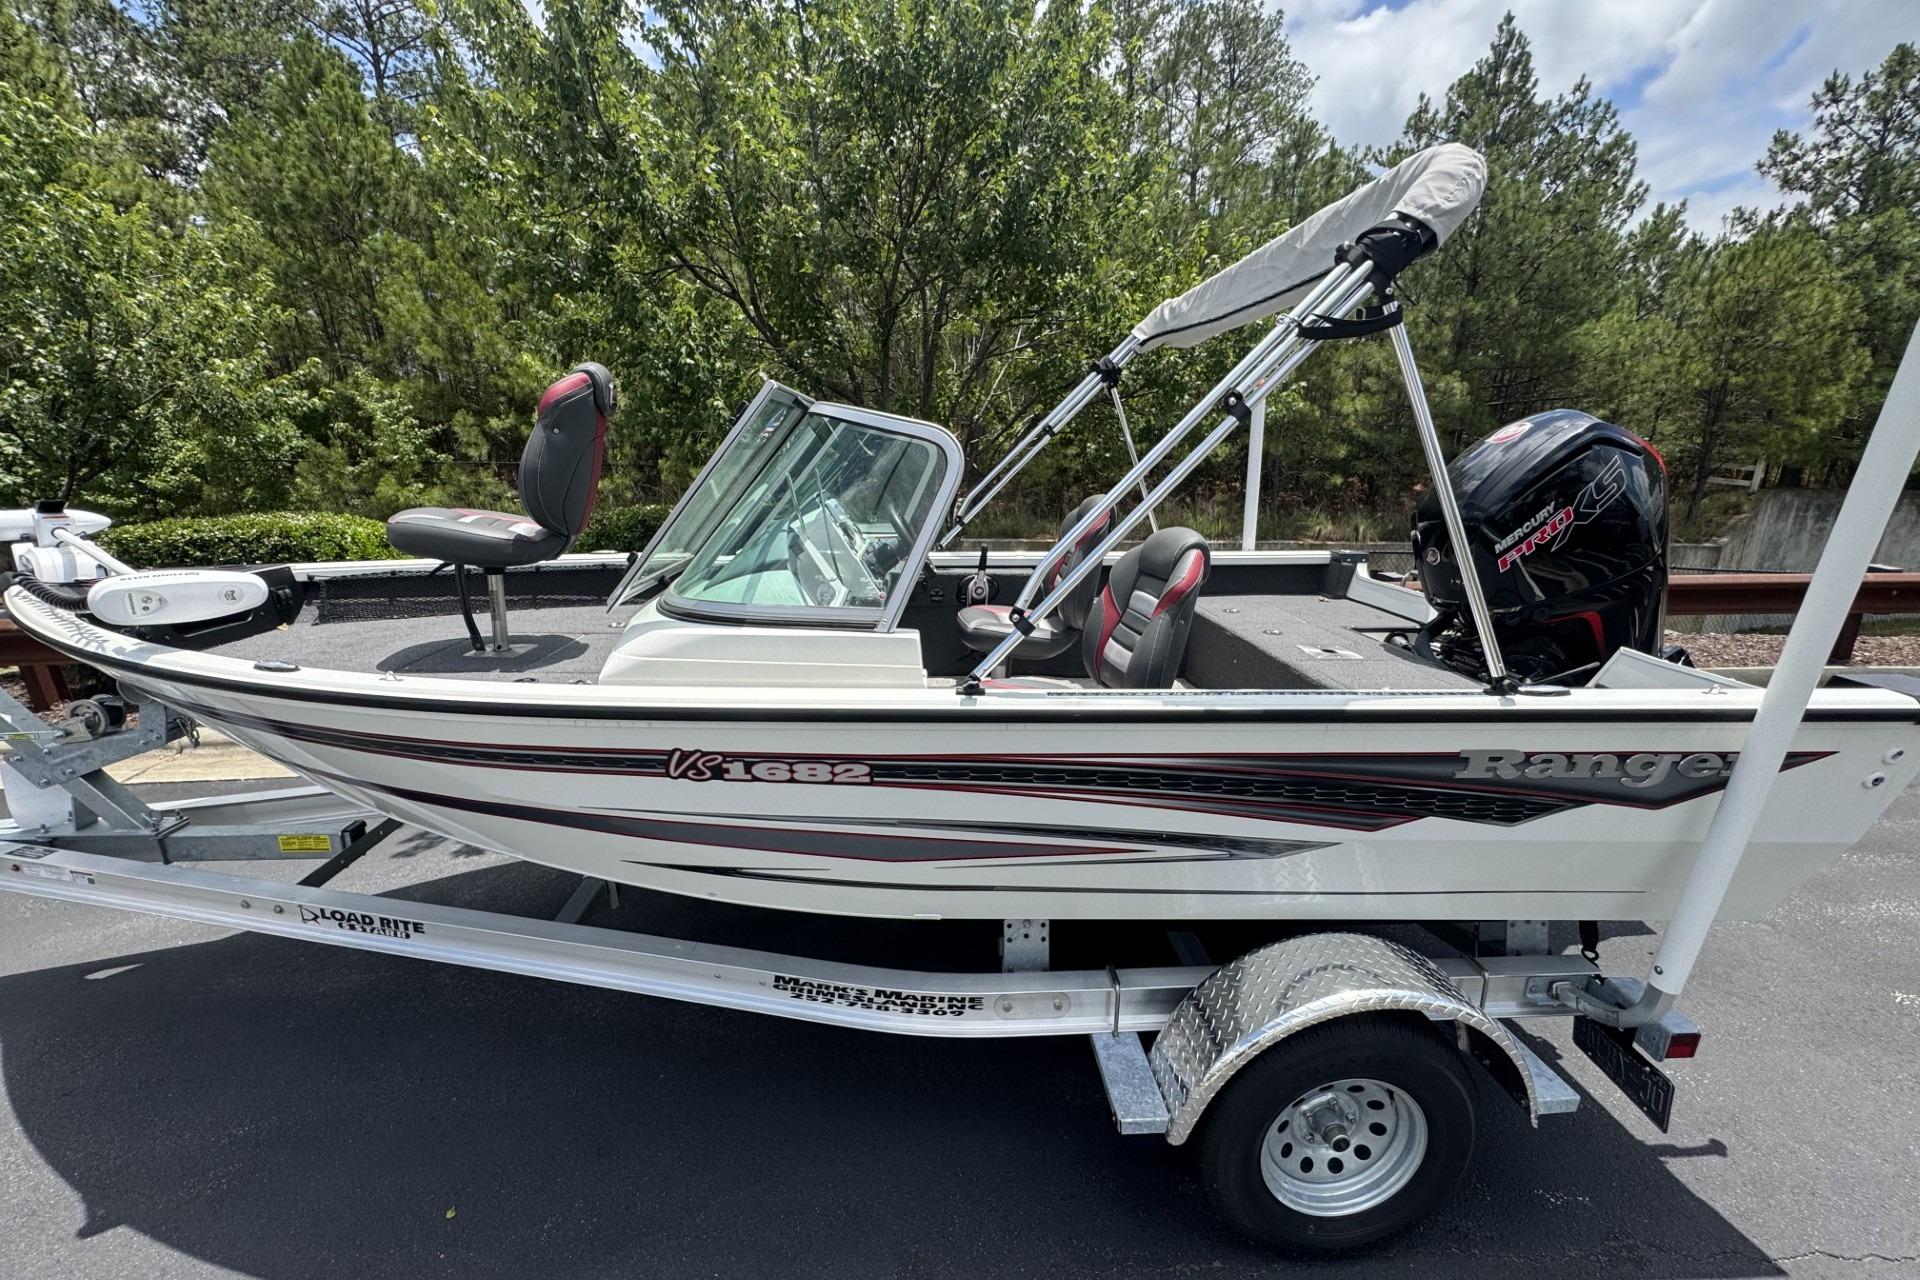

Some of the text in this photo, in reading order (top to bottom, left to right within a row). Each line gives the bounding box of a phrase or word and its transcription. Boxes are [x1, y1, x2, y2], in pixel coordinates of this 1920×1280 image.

[1494, 501, 1556, 554] MERCURY
[1498, 506, 1574, 573] PRO
[669, 750, 871, 783] VS 1682
[320, 907, 374, 926] LOAD
[379, 916, 425, 934] RITE
[790, 992, 965, 1017] 252-758-3309
[874, 989, 985, 1004] MARINE
